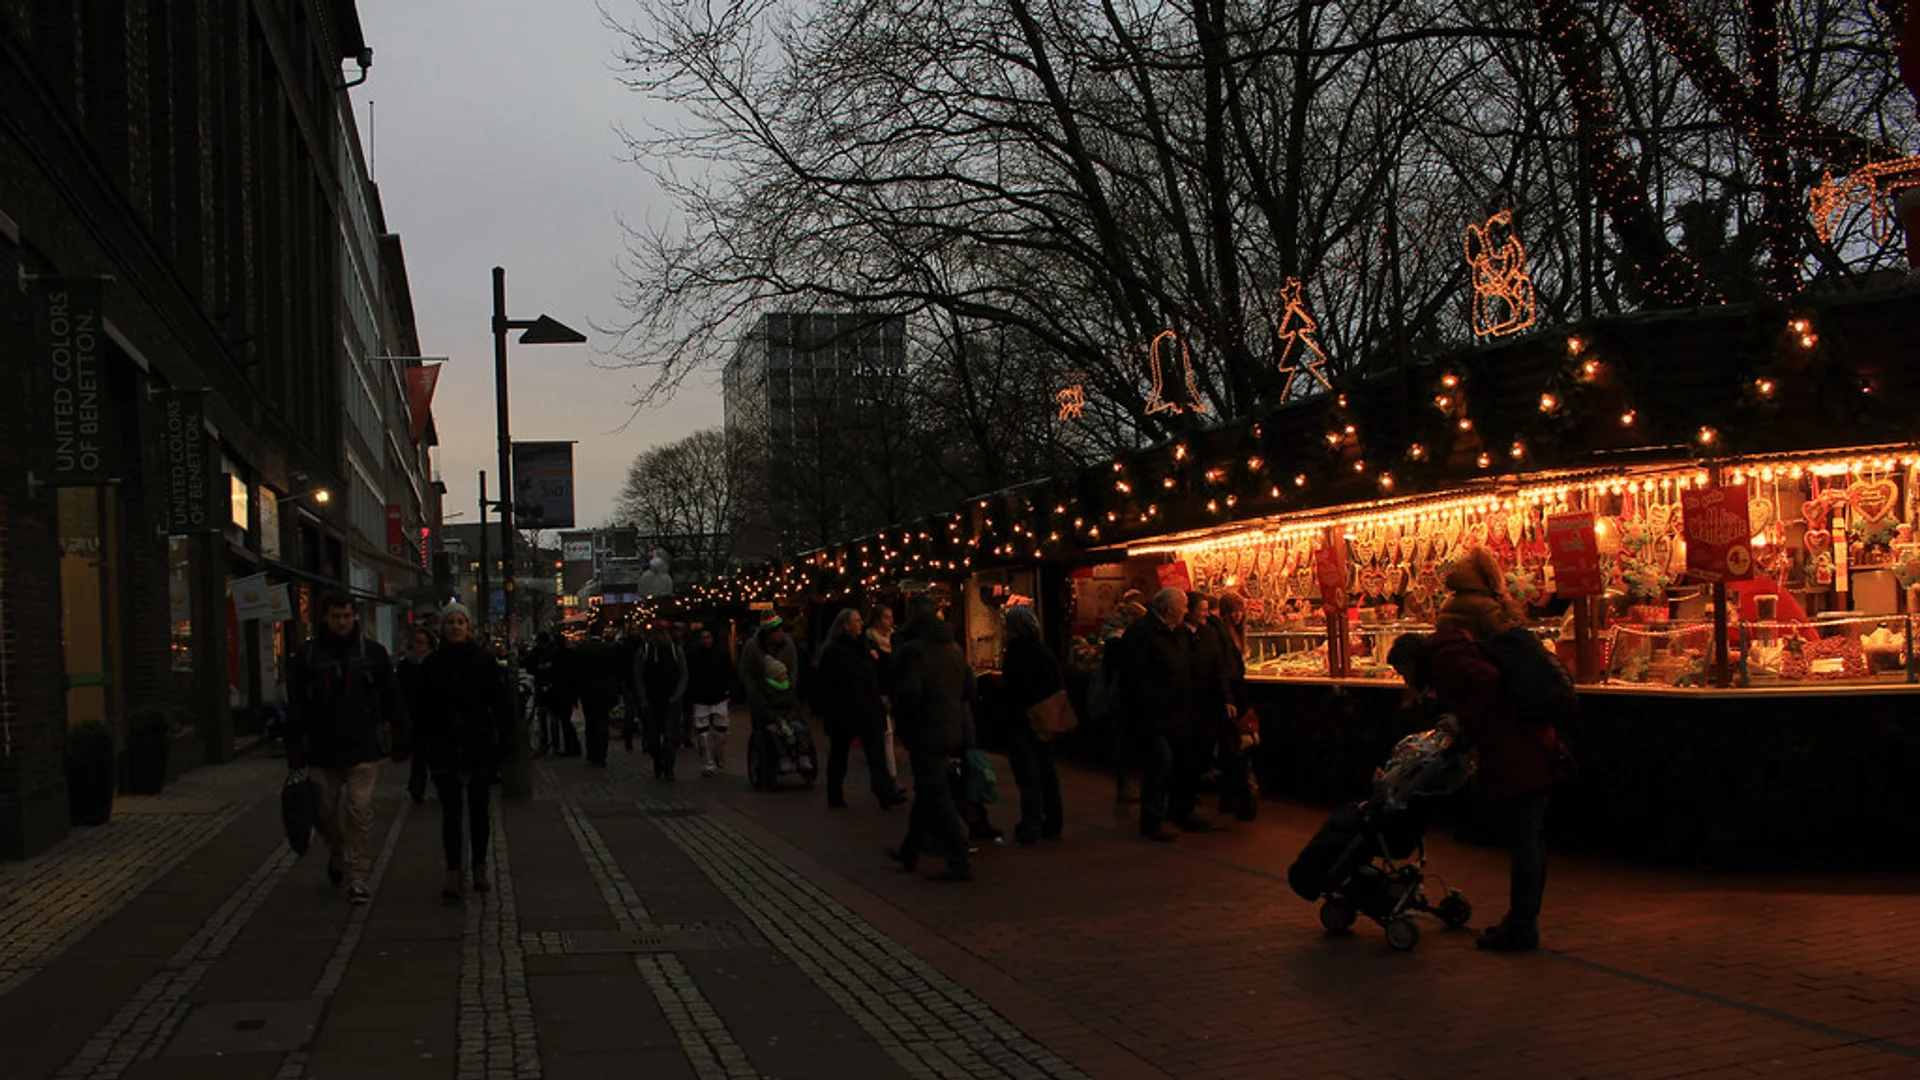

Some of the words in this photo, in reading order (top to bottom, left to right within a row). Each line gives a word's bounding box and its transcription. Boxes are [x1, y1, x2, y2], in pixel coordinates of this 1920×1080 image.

[49, 291, 72, 382] COLORS
[54, 387, 75, 472] UNITED
[80, 440, 99, 470] OF
[166, 399, 184, 463] COLORS
[172, 465, 188, 525] UNITED
[190, 499, 203, 525] OF
